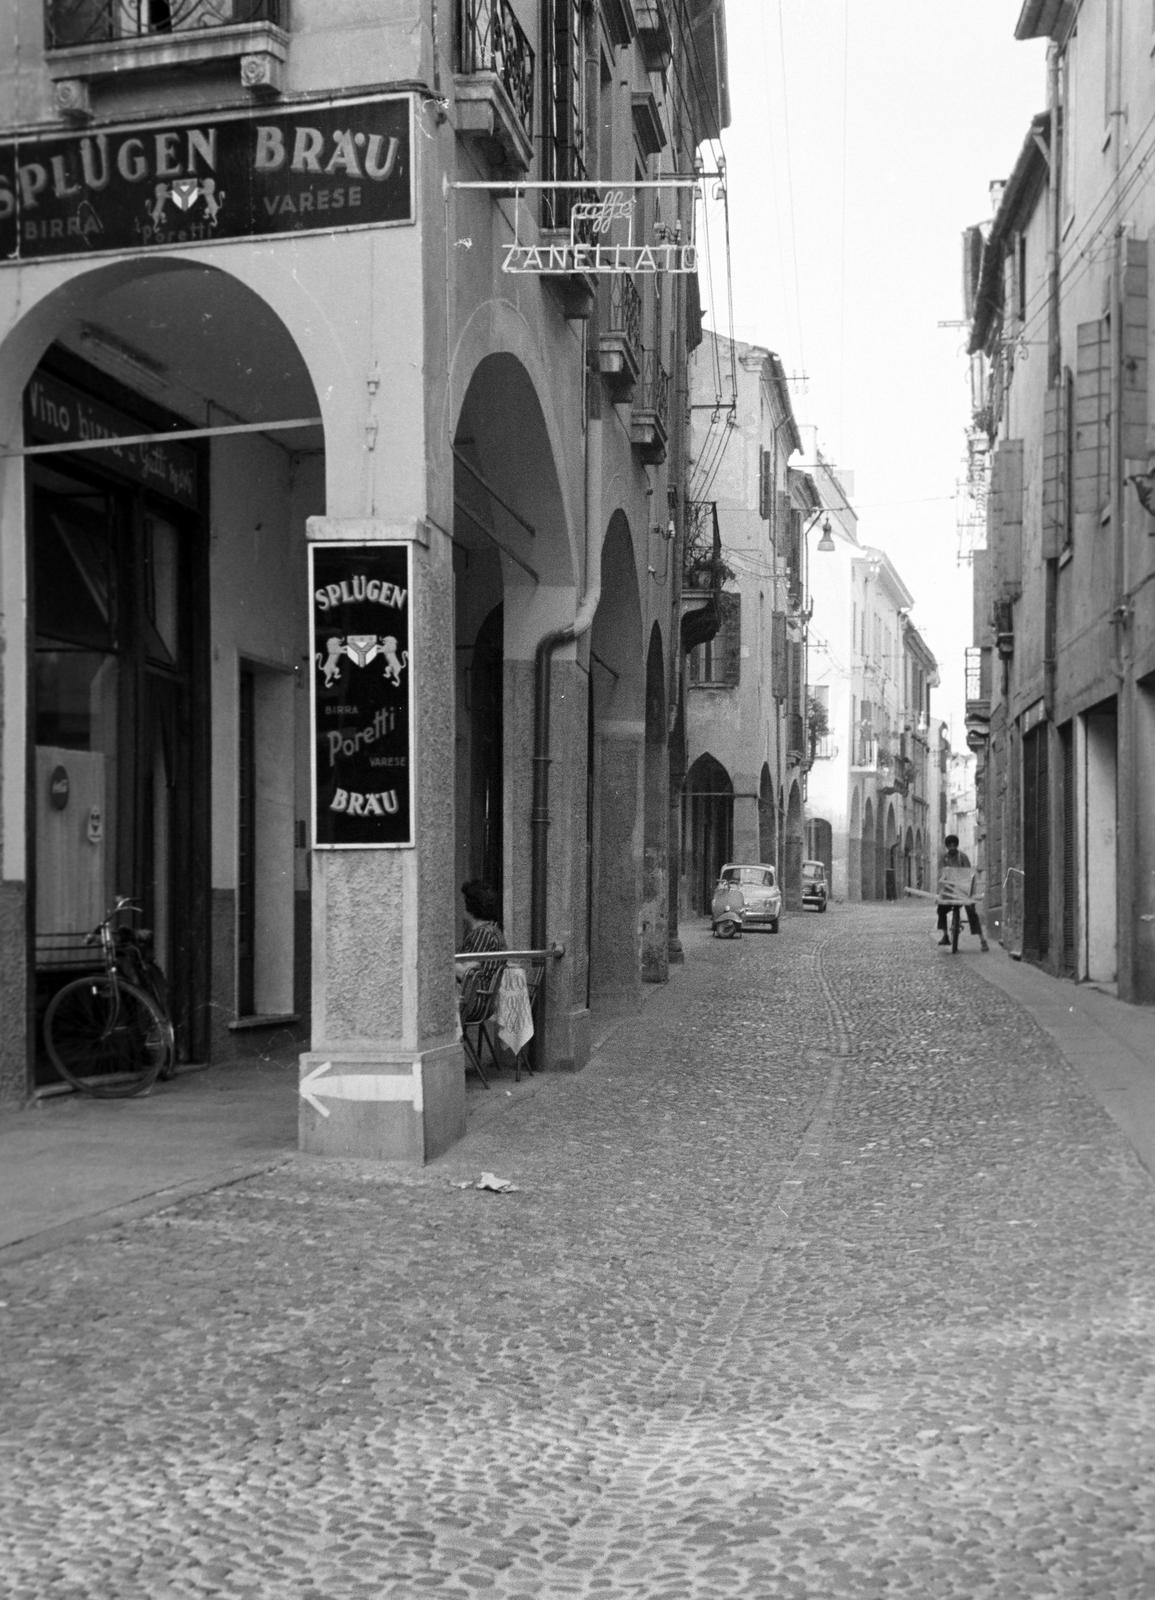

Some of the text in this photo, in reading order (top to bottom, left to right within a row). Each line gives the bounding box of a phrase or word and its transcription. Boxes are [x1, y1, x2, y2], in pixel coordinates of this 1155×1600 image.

[255, 126, 399, 181] BRÄU
[25, 215, 101, 240] BIRRA
[263, 186, 361, 216] VARESE
[501, 243, 698, 272] ZANELLATO
[325, 705, 358, 714] BIRRA
[327, 706, 395, 767] Poretti
[369, 757, 406, 767] VARESE
[330, 788, 399, 816] BRÄU
